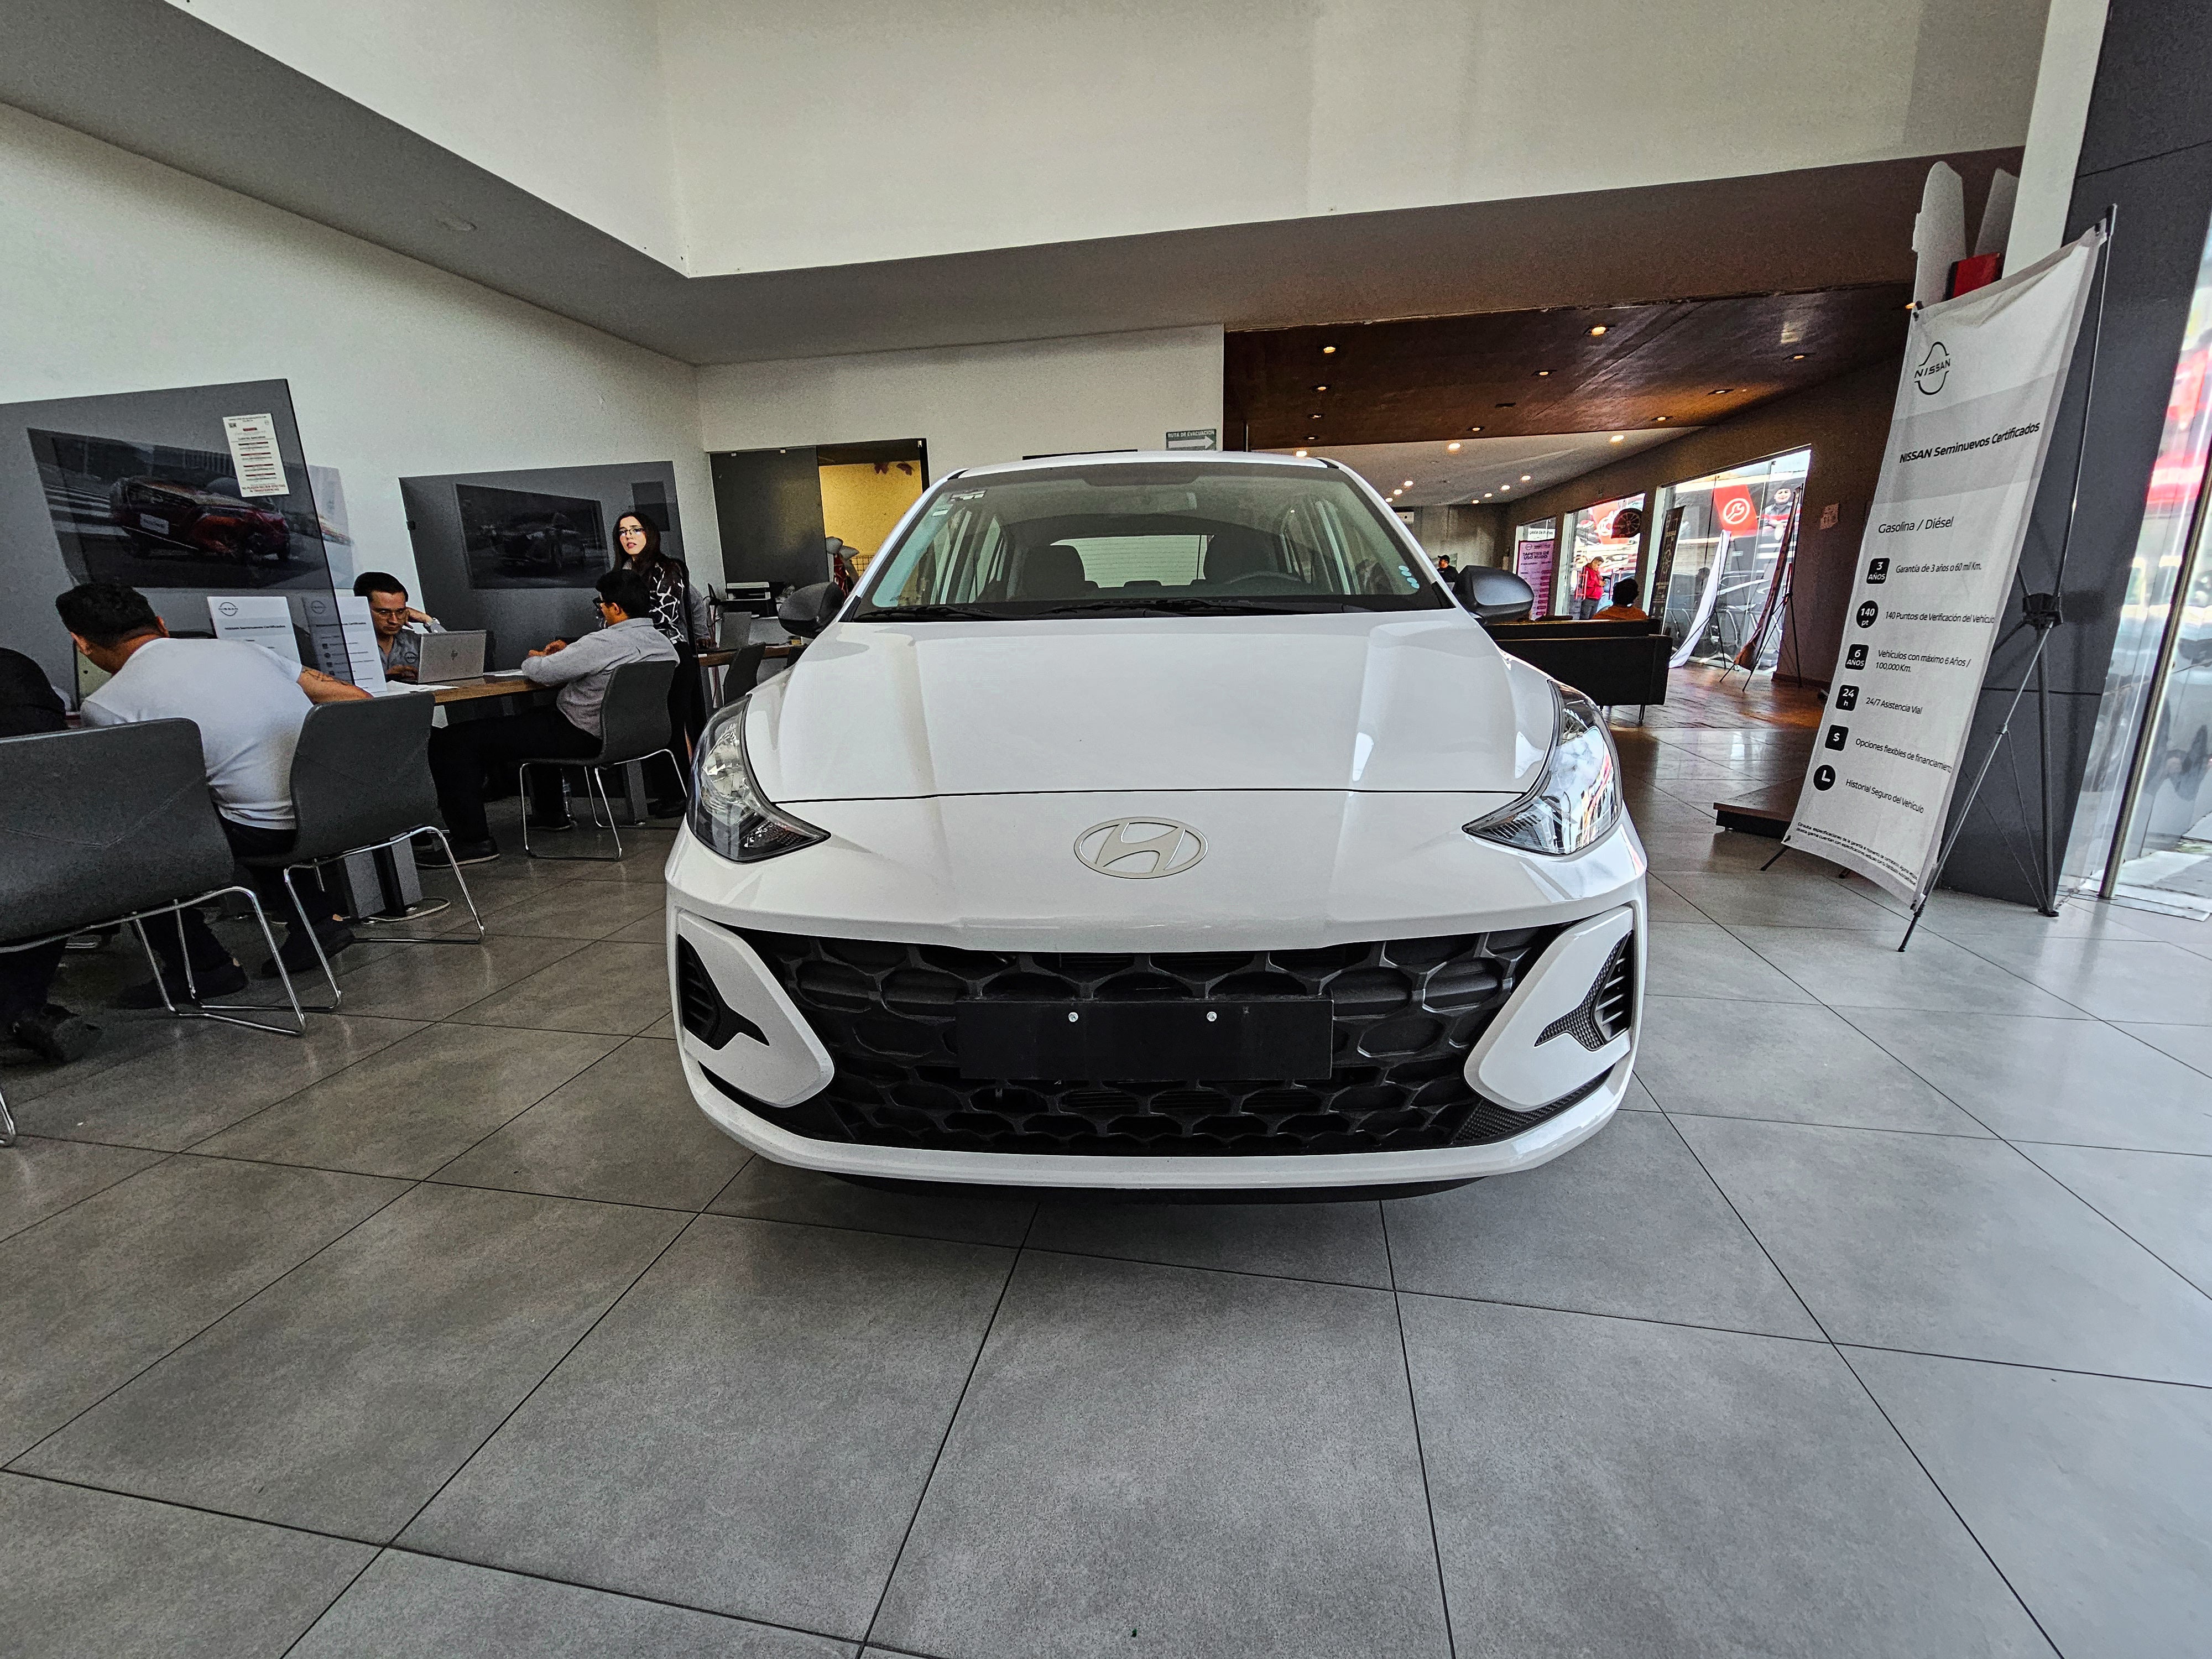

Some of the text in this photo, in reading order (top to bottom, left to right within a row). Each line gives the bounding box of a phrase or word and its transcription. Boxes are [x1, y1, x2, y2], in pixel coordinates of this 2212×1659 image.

[1914, 358, 1950, 379] NISSAN
[1899, 422, 2040, 463] NISSAN Seminuevos Certificados
[1878, 521, 1915, 534] Gasolina
[1925, 516, 1954, 529] Diésel
[1876, 562, 1883, 570] 3
[1896, 564, 1920, 573] Garantía
[1921, 564, 1929, 572] de
[1936, 564, 1949, 572] años
[1954, 563, 1963, 571] 60
[1861, 608, 1875, 617] 140
[1886, 611, 1896, 619] 140
[1929, 613, 1961, 622] Verificación
[1962, 613, 1972, 622] del
[1855, 649, 1861, 658] 6
[1878, 649, 1907, 660] Vehículos
[1921, 654, 1944, 664] máximo
[1949, 657, 1966, 667] Años
[1876, 662, 1900, 671] 100,000
[1842, 688, 1854, 698] 24
[1866, 697, 1881, 706] 24/7
[1881, 700, 1911, 712] Asistencia
[1856, 738, 1884, 752] Opciones
[1884, 745, 1907, 758] flexibles
[1846, 779, 1924, 813] Historial Seguro del Vehículo
